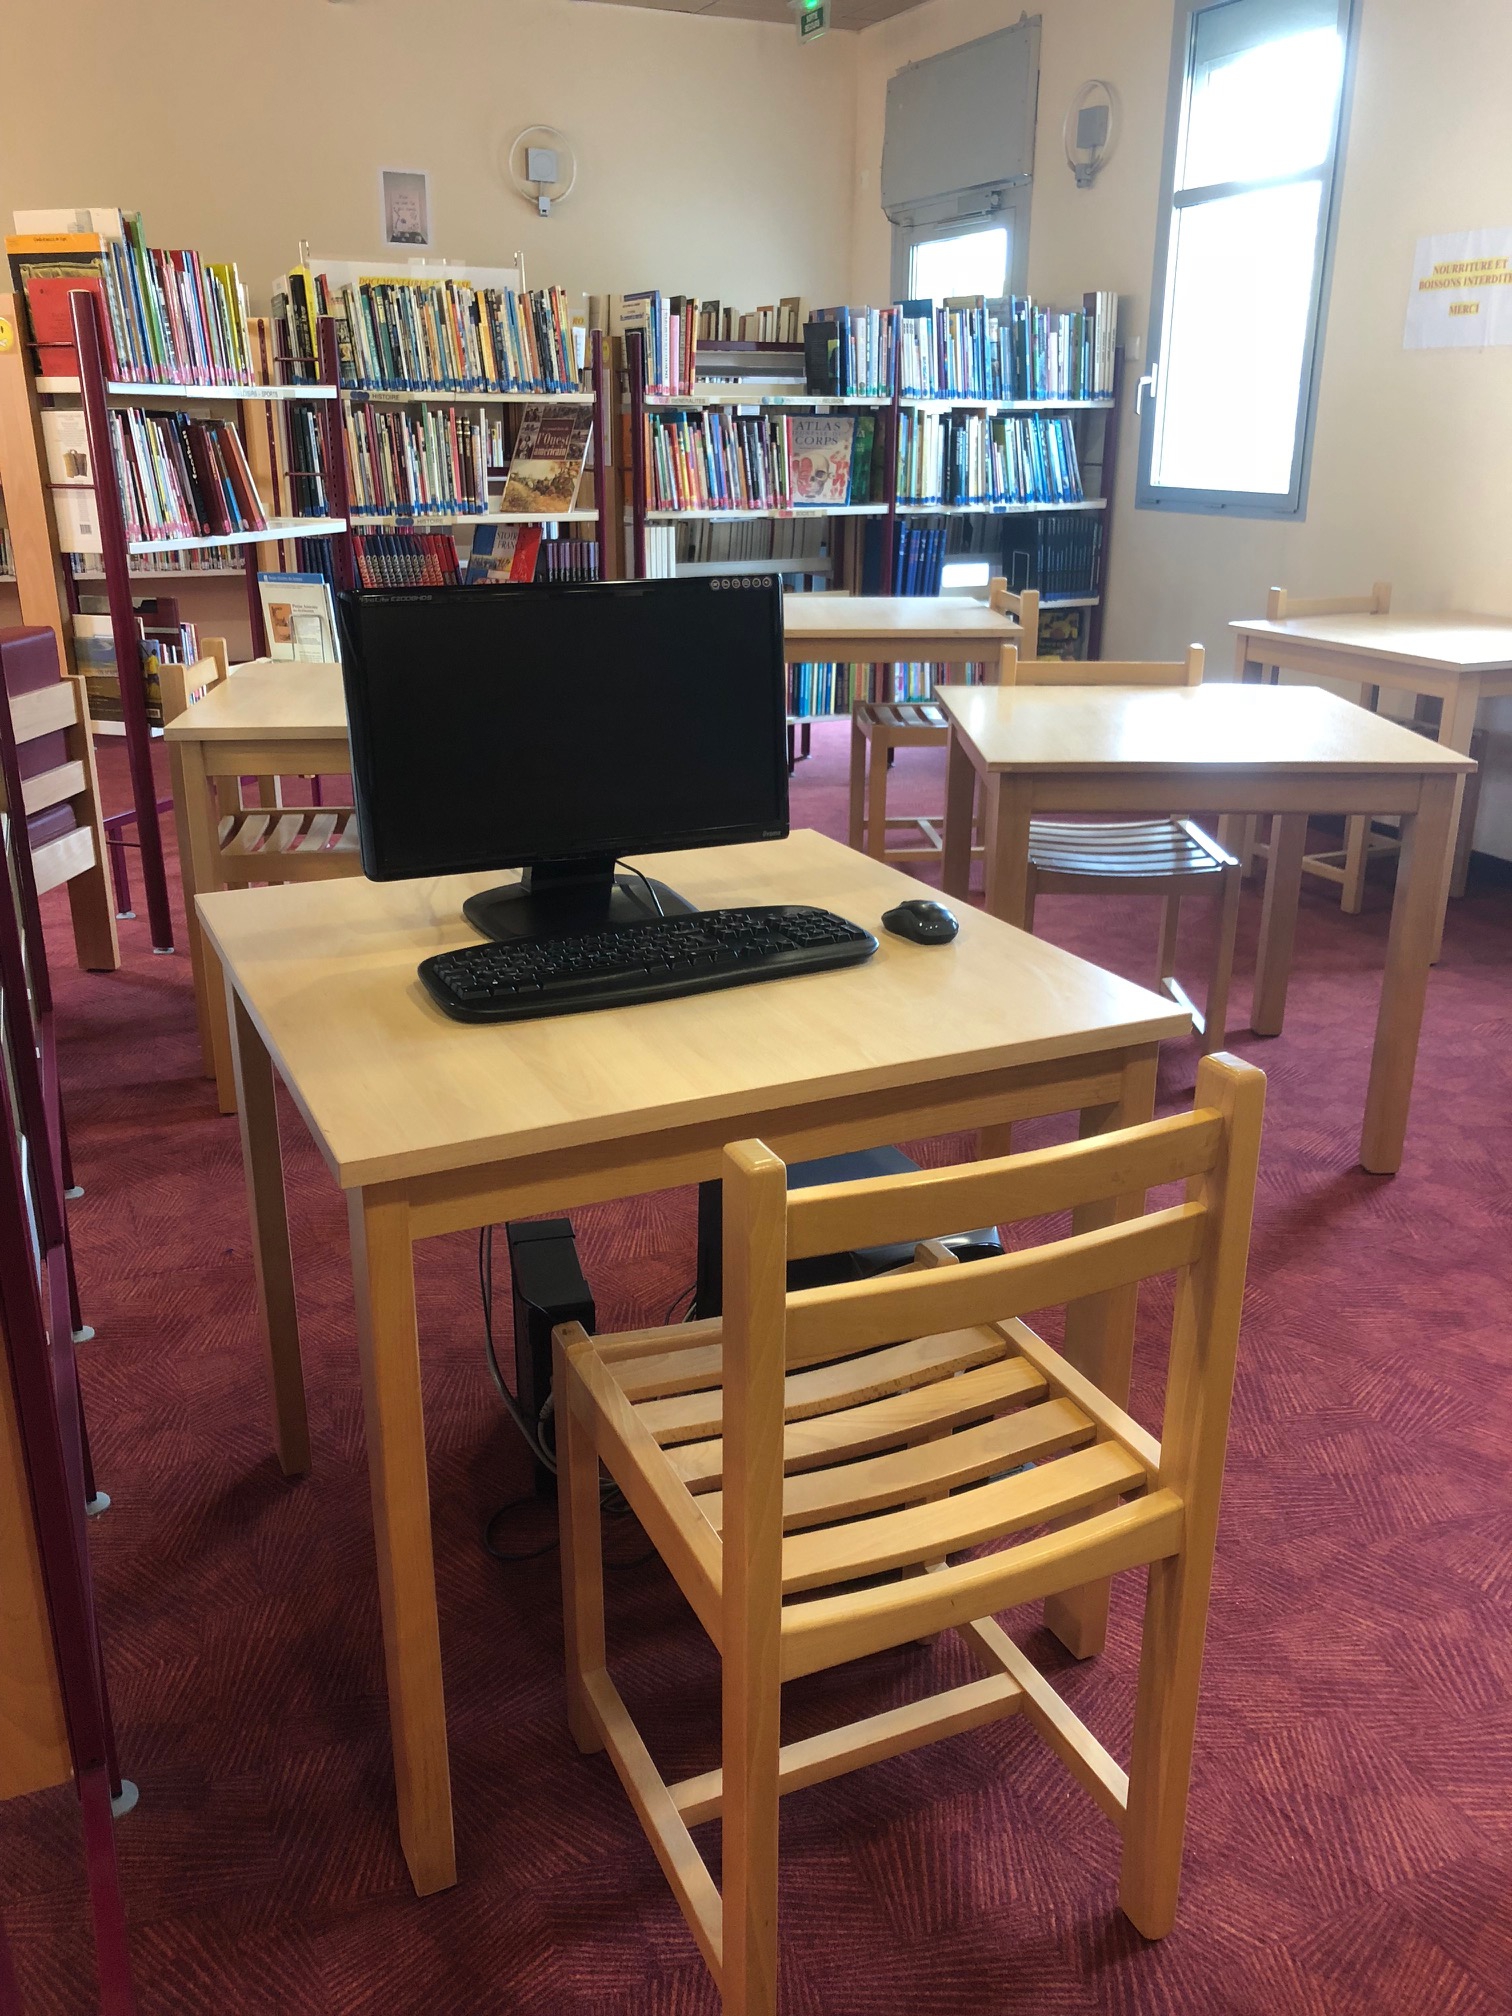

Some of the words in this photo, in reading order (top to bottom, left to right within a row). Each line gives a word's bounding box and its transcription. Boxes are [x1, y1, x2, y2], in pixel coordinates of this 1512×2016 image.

[1433, 261, 1493, 275] NOURRITURE
[1495, 259, 1508, 269] ET
[1419, 277, 1461, 290] BOISSONS
[1449, 303, 1480, 315] MERCI
[796, 421, 841, 431] ATLAS
[795, 436, 838, 446] CORPS
